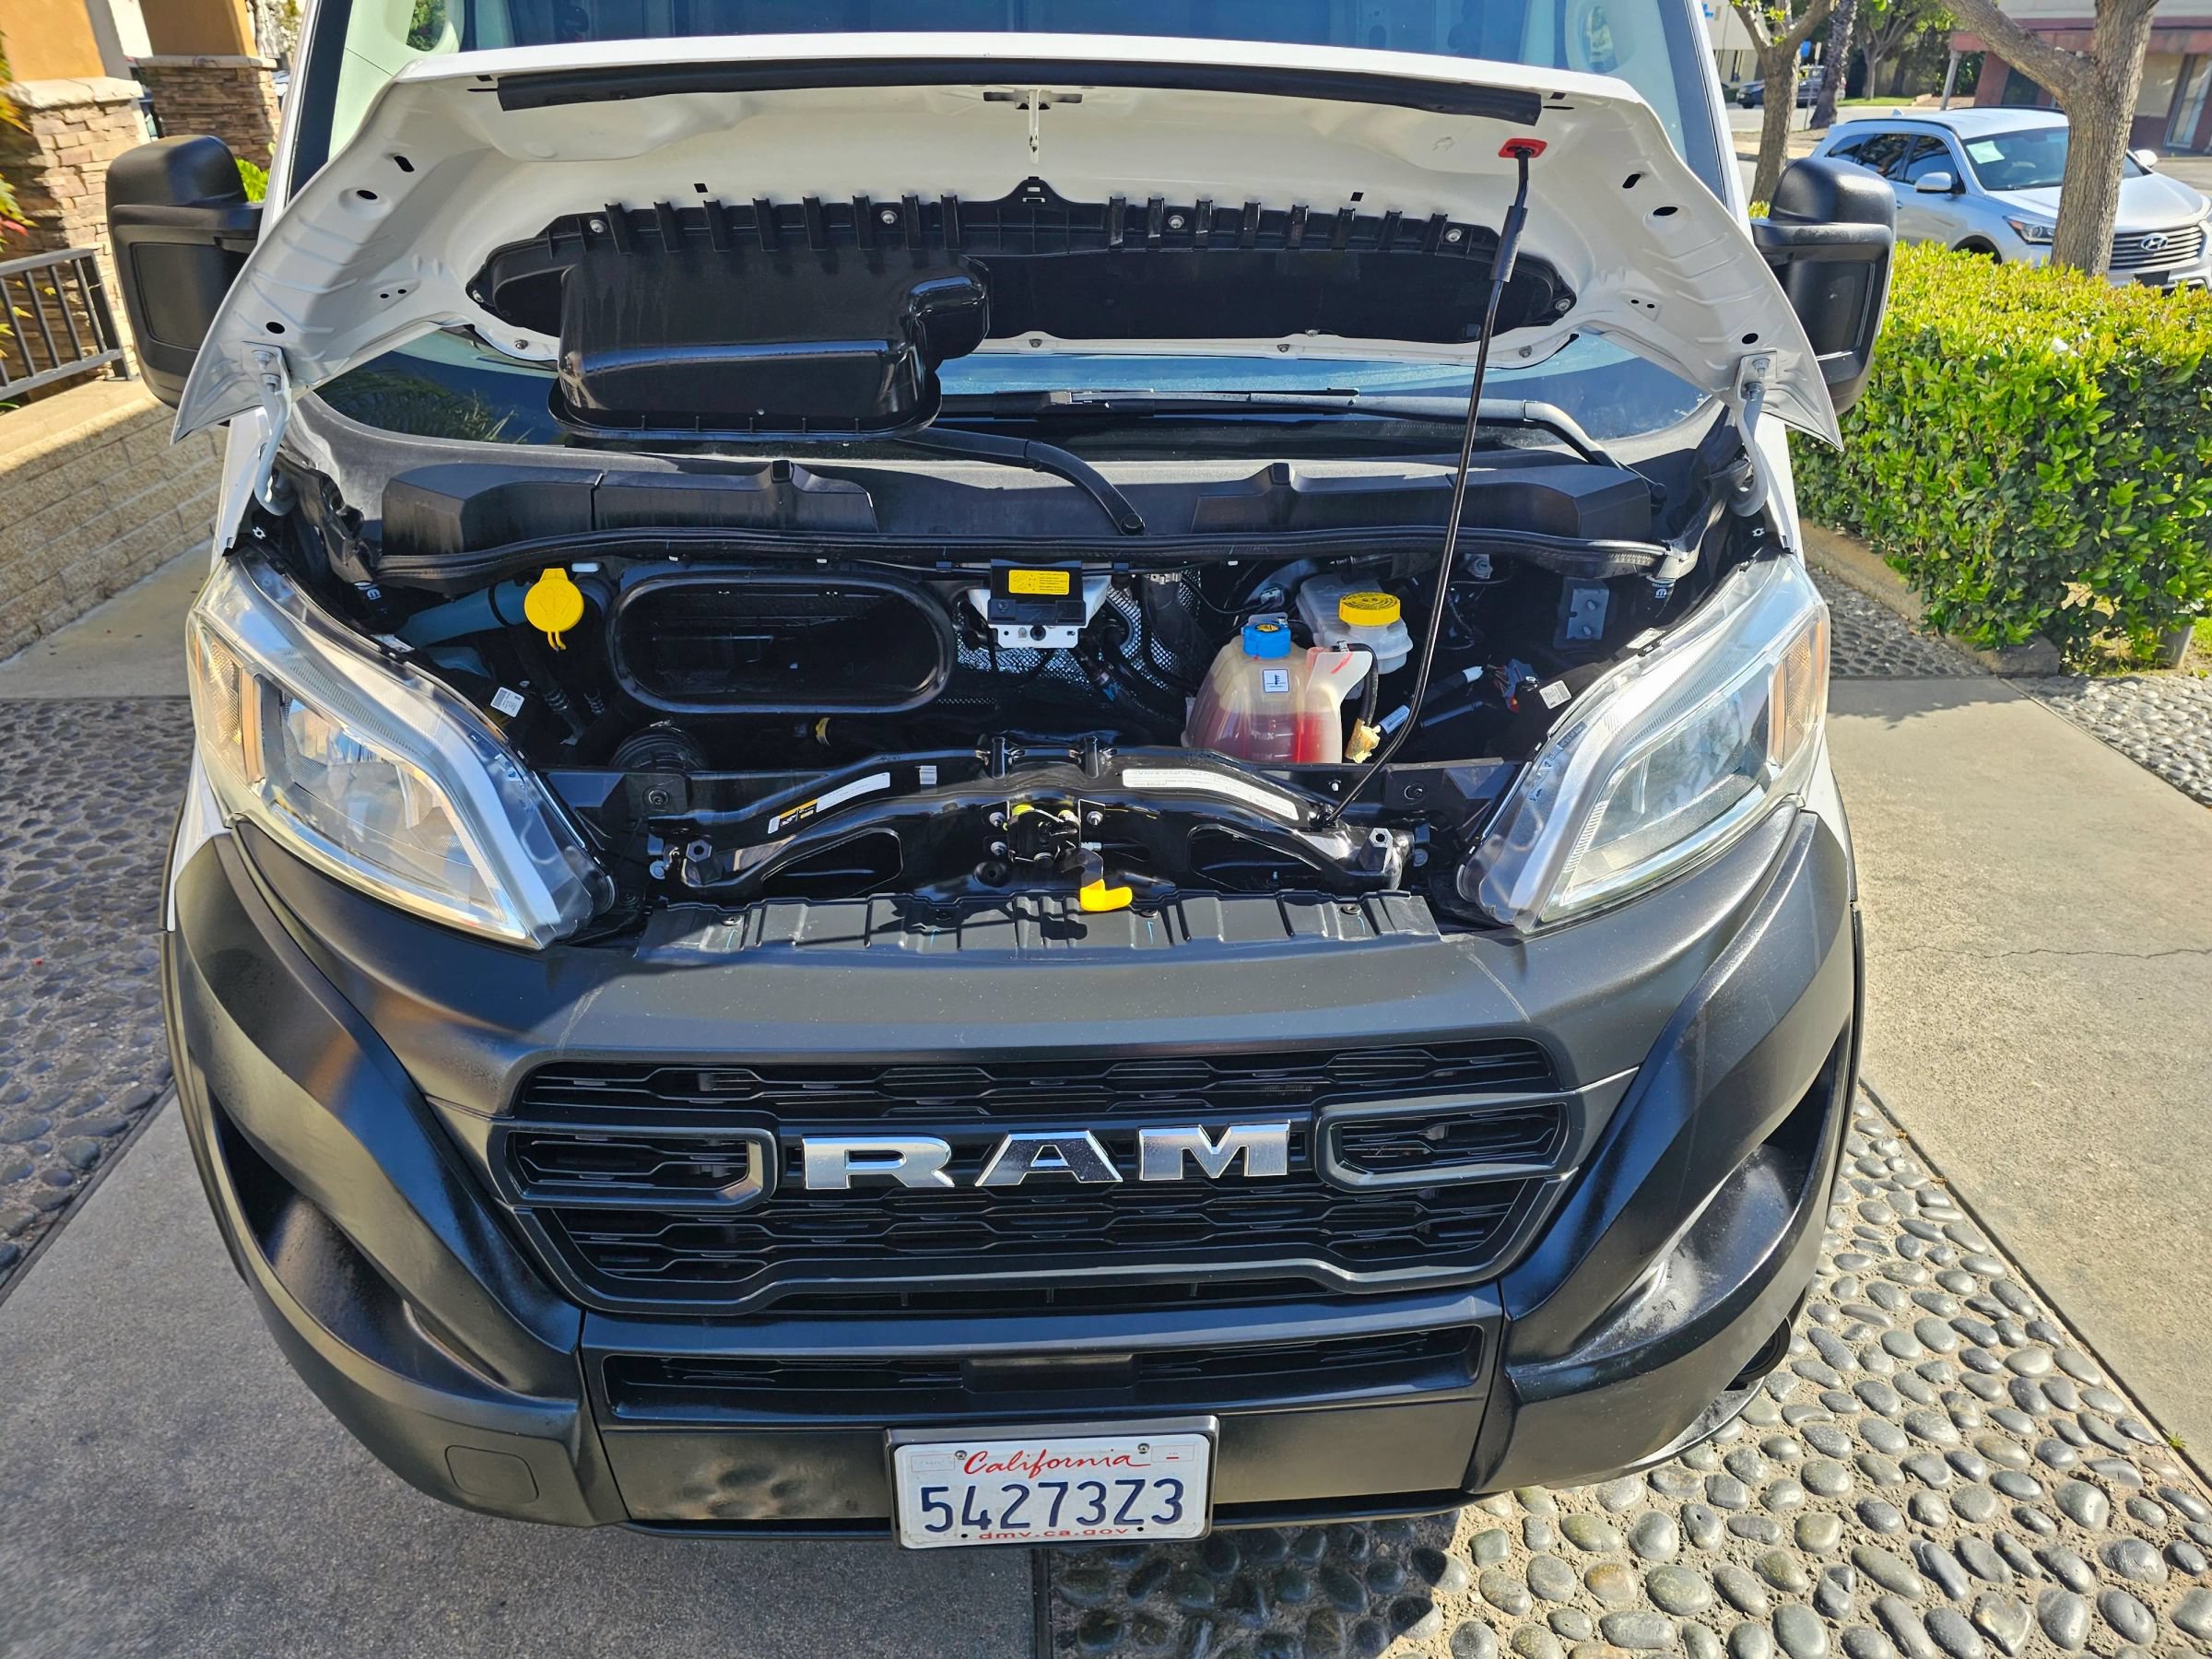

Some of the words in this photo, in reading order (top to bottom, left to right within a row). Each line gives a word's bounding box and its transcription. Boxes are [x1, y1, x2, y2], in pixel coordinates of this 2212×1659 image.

[802, 1119, 1291, 1190] RAM
[963, 1447, 1151, 1479] California
[920, 1477, 1185, 1533] 54273Z3
[978, 1526, 1129, 1541] dmv.ca.gov
